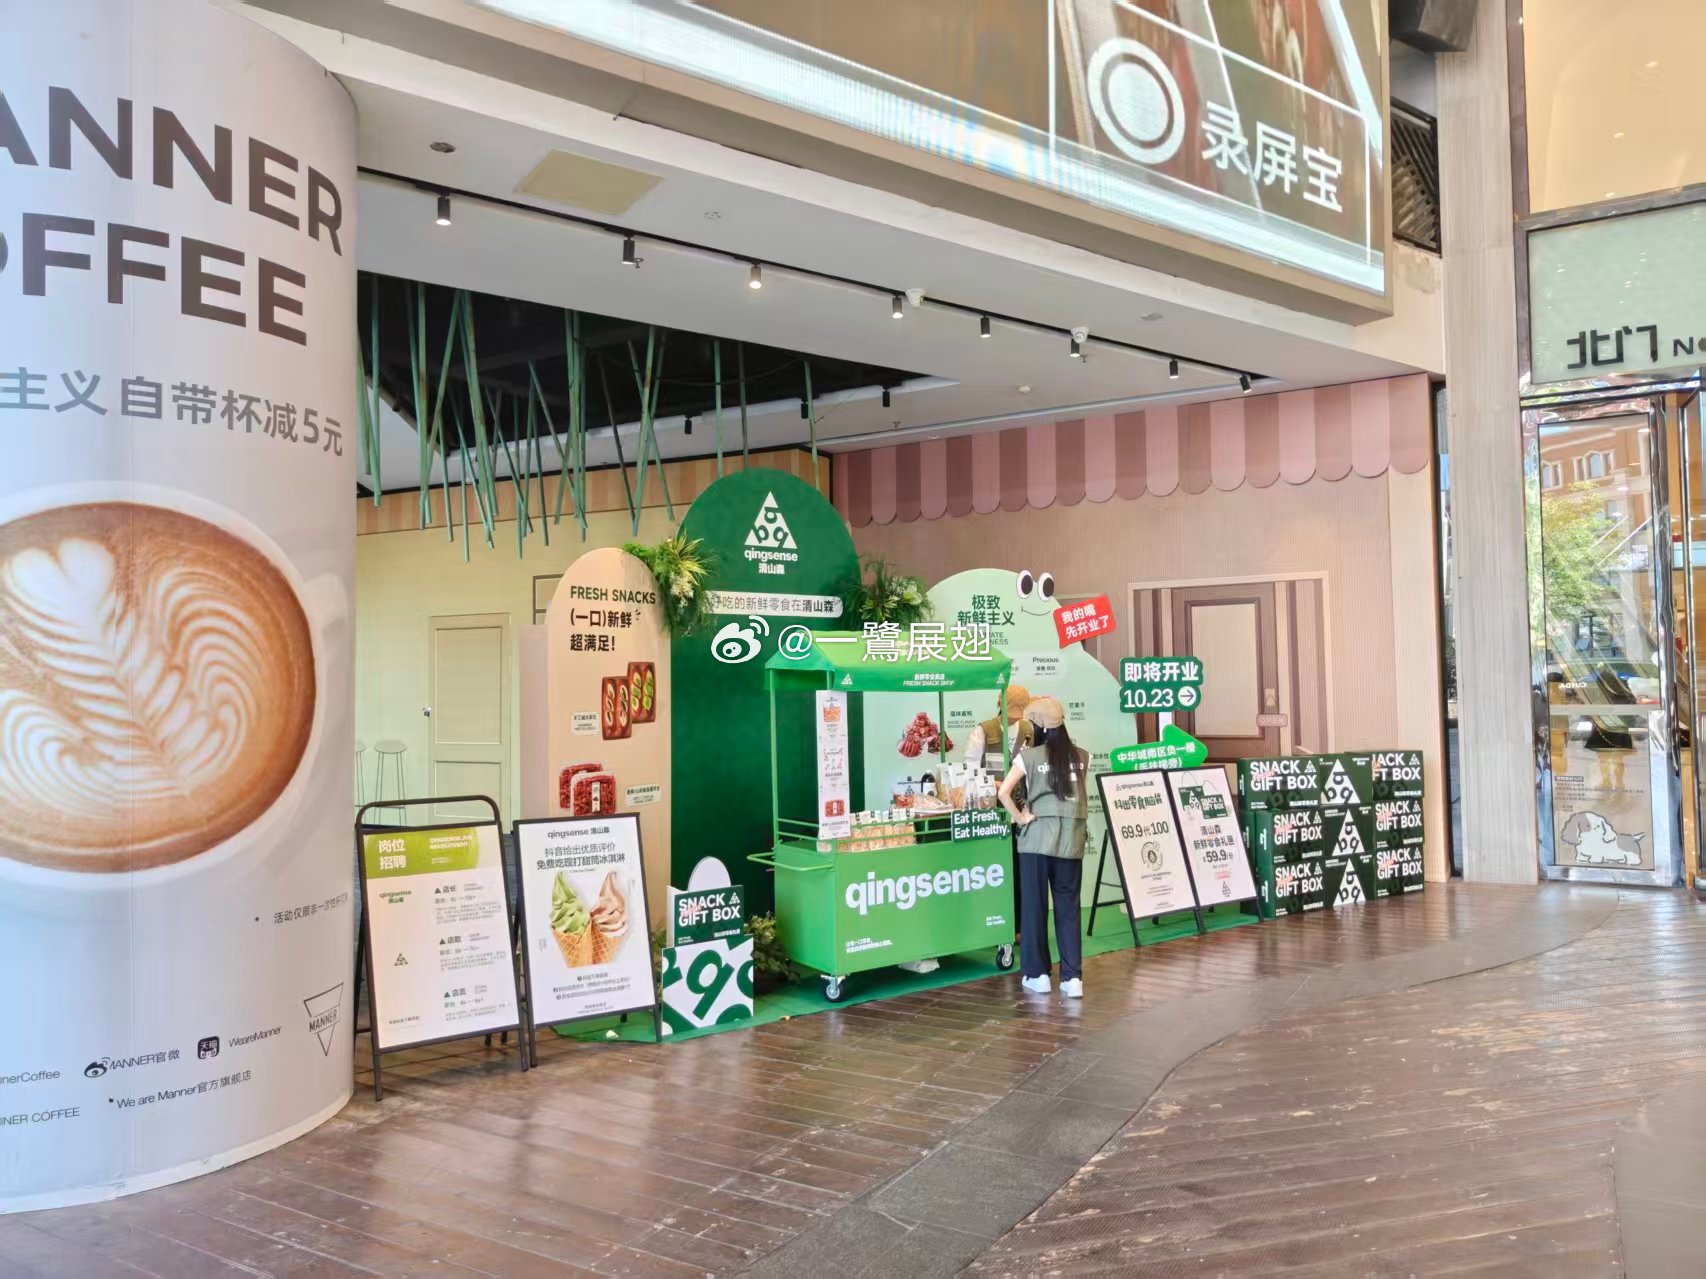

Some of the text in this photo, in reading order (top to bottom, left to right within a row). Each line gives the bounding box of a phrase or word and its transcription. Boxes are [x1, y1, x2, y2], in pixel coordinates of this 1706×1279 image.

[1201, 101, 1343, 214] 录屏宝
[0, 212, 307, 346] FFEE
[1566, 324, 1659, 370] 北门
[121, 376, 343, 457] 自带杯减5元
[745, 548, 799, 563] qingsense
[570, 585, 657, 605] FRESH SNACKS
[971, 594, 1001, 610] 极致
[957, 610, 1015, 627] 新鲜主义
[1061, 603, 1096, 624] 我的嘴
[1065, 615, 1109, 640] 先开业了
[570, 634, 616, 652] 超满足!
[1124, 661, 1200, 682] 即将开业
[1123, 688, 1174, 708] 10.23
[1250, 760, 1301, 774] SNACK
[1372, 753, 1405, 767] ACK
[1392, 767, 1421, 780] BOX
[1250, 774, 1318, 792] GIFT BOX
[954, 810, 1000, 825] Eat Fresh,
[1375, 800, 1410, 817] SNACK
[1274, 811, 1311, 829] SNACK
[1376, 814, 1422, 832] GIFT BOX
[547, 829, 589, 840] qingsense
[954, 823, 1010, 839] Eat Healthy.
[1274, 825, 1322, 845] GIFT BOX
[378, 838, 406, 853] 岗位
[545, 841, 616, 858] 抖音给出优质评价
[379, 855, 407, 870] 招聘
[536, 853, 626, 871] 免费吃现打甜筒冰淇淋
[1377, 847, 1411, 865] SNACK
[1275, 863, 1312, 881] SNACK
[1377, 860, 1423, 880] GIFT BOX
[845, 863, 1004, 916] qingsense
[1276, 876, 1323, 898] GIFT BOX
[678, 893, 726, 912] SNACK
[678, 905, 741, 927] GIFT BOX
[309, 1009, 338, 1033] MANNER
[117, 1098, 135, 1109] We
[138, 1095, 155, 1105] are
[0, 1107, 80, 1126] NER COFFEE
